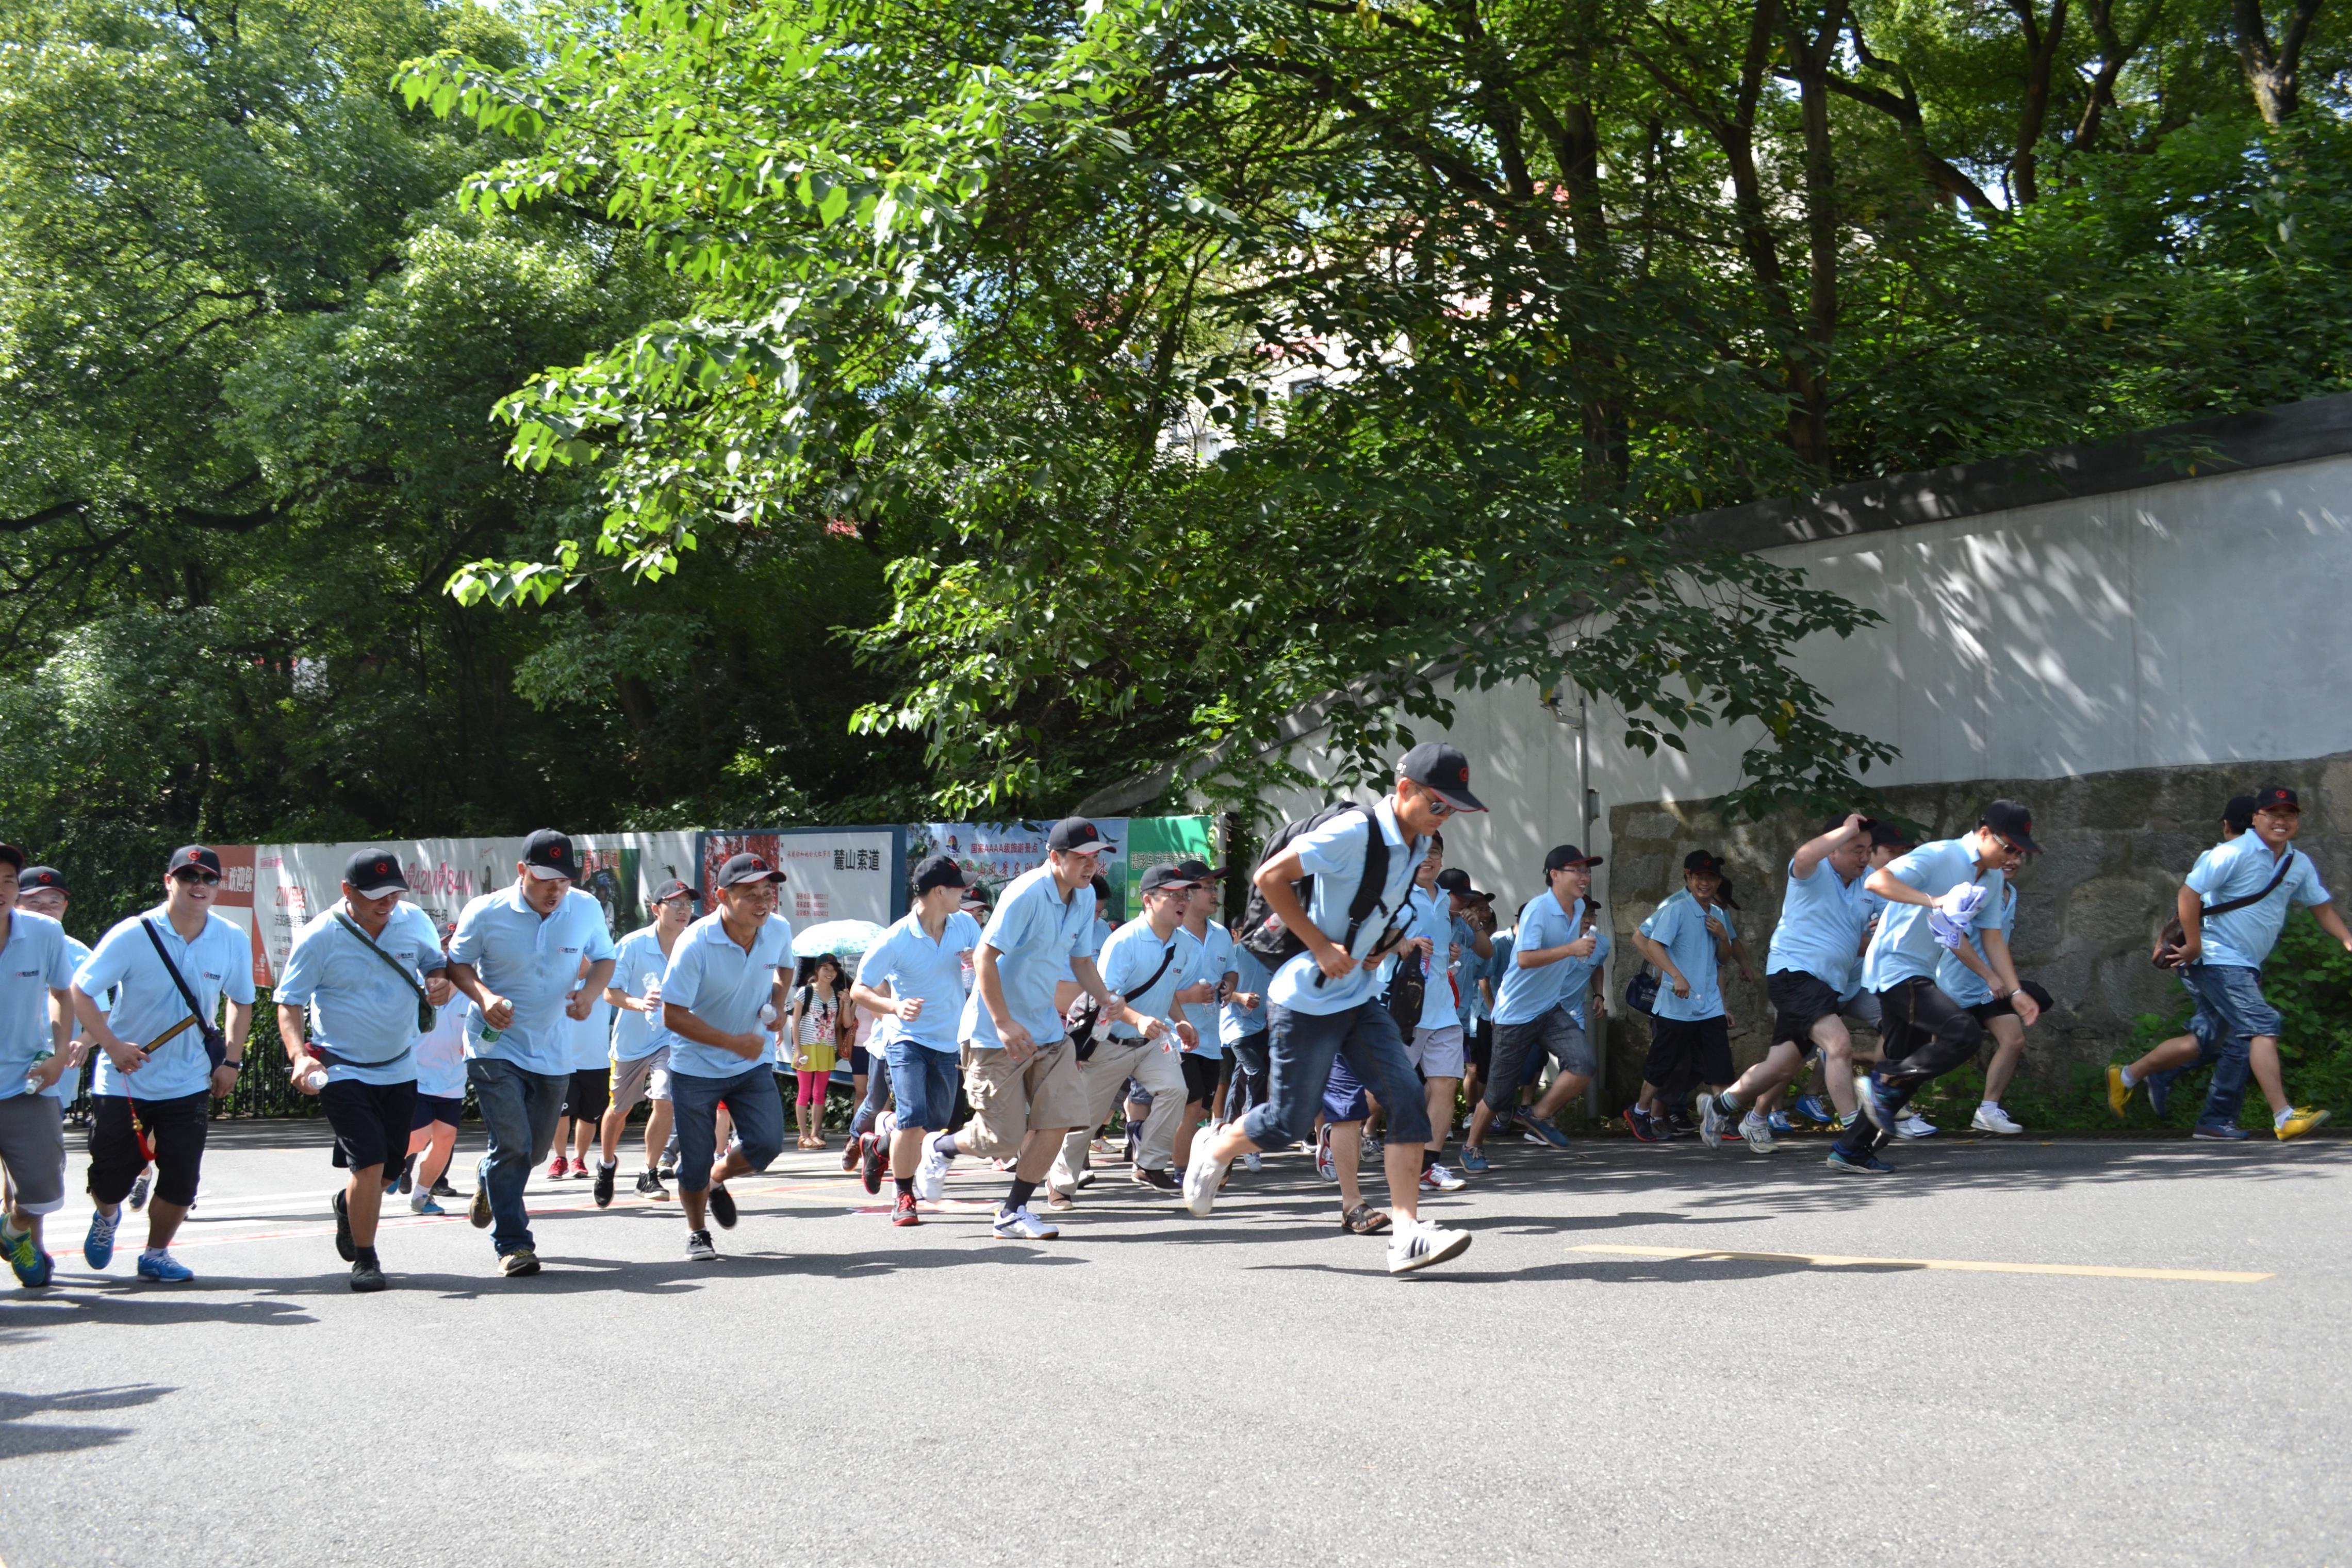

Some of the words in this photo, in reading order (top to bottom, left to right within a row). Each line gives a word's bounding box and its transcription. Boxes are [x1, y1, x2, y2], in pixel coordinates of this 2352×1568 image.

[971, 843, 1039, 854] 国家AAAA级旅游景点
[834, 849, 880, 870] 麓山索道
[228, 866, 253, 892] 欢迎您
